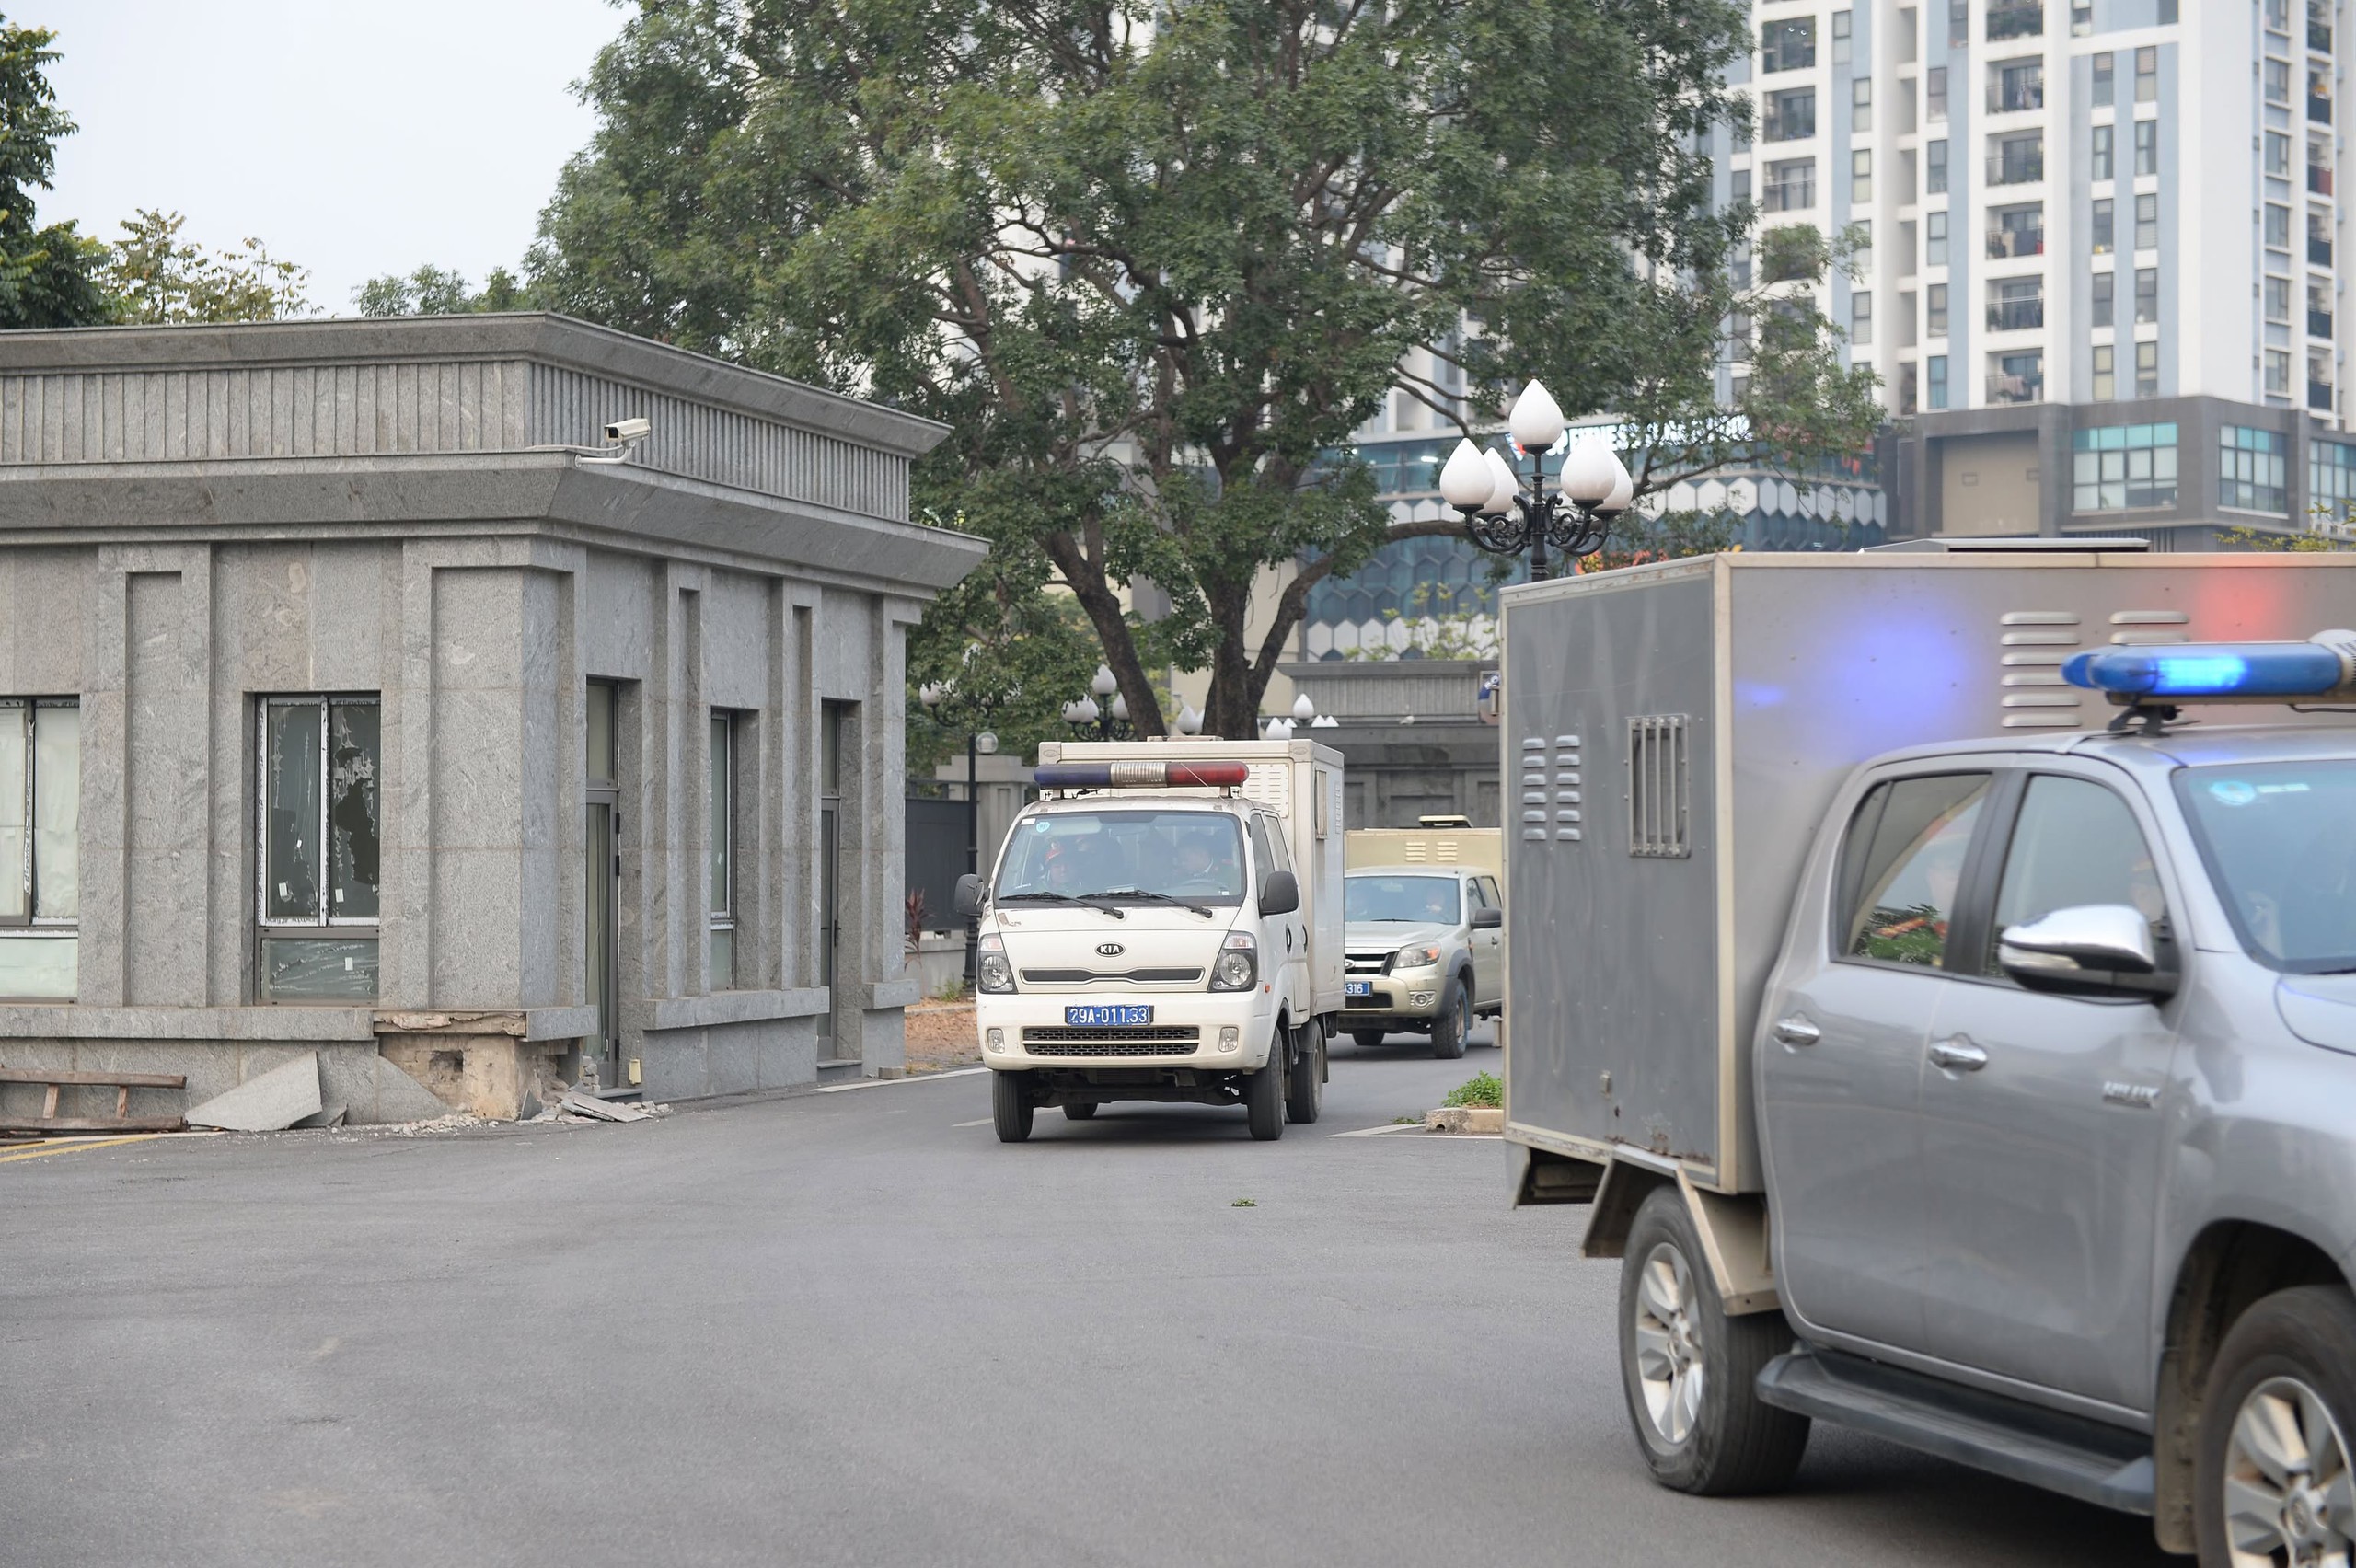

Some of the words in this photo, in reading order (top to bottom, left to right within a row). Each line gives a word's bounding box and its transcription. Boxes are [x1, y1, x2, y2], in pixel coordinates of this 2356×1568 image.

[1100, 945, 1120, 953] KIA
[1345, 983, 1364, 994] 316
[1069, 1007, 1148, 1023] 29A-011.33
